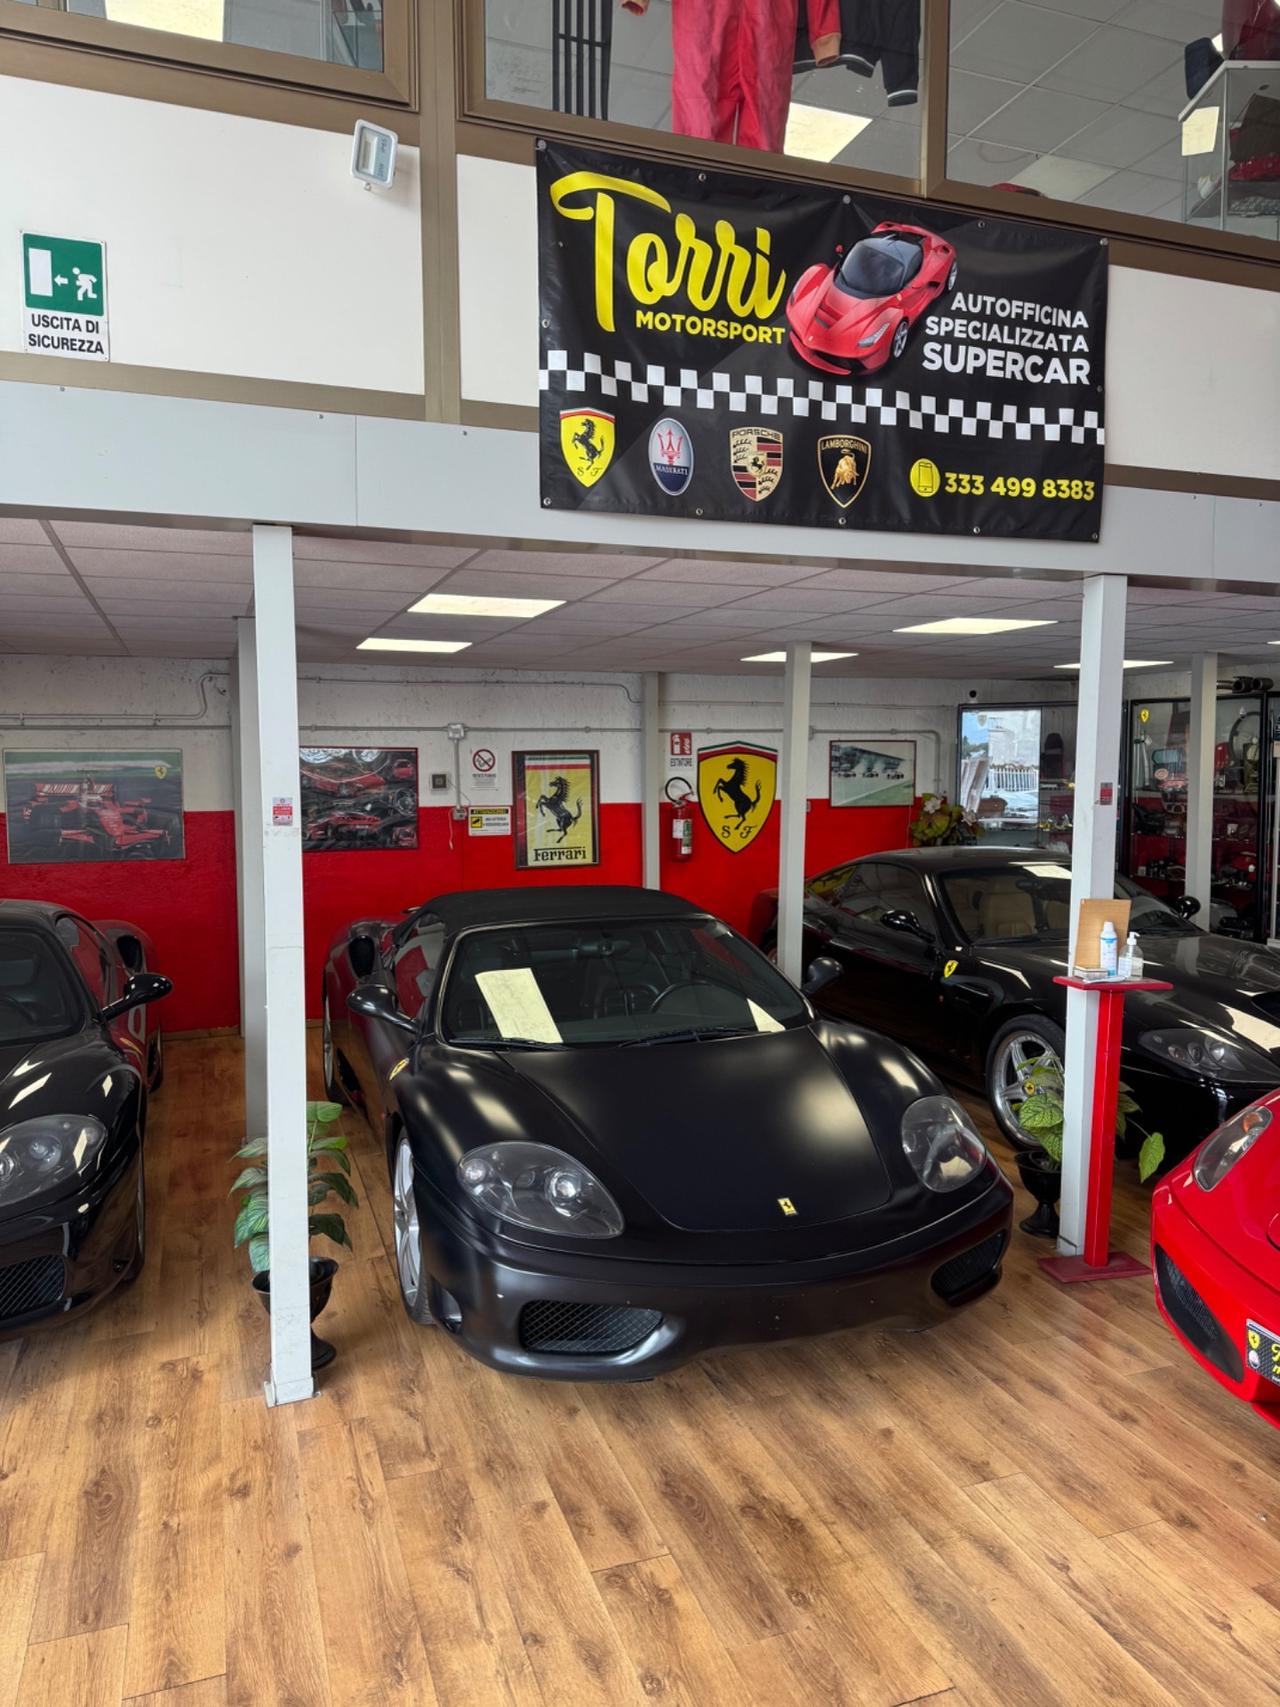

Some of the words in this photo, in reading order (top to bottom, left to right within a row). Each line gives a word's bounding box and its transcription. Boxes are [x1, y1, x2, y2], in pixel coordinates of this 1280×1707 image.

[550, 171, 786, 332] Torri
[31, 313, 82, 332] USCITA
[85, 320, 99, 334] DI
[951, 292, 1089, 328] AUTOFFICINA
[636, 310, 785, 344] MOTORSPORT
[925, 316, 1089, 352] SPECIALIZZATA
[28, 333, 104, 354] SICUREZZA
[922, 342, 1090, 385] SUPERCAR
[732, 428, 781, 440] PORSCHE
[944, 472, 984, 496] 333
[990, 477, 1036, 498] 499
[1042, 479, 1095, 501] 8383
[533, 846, 587, 862] Ferrari
